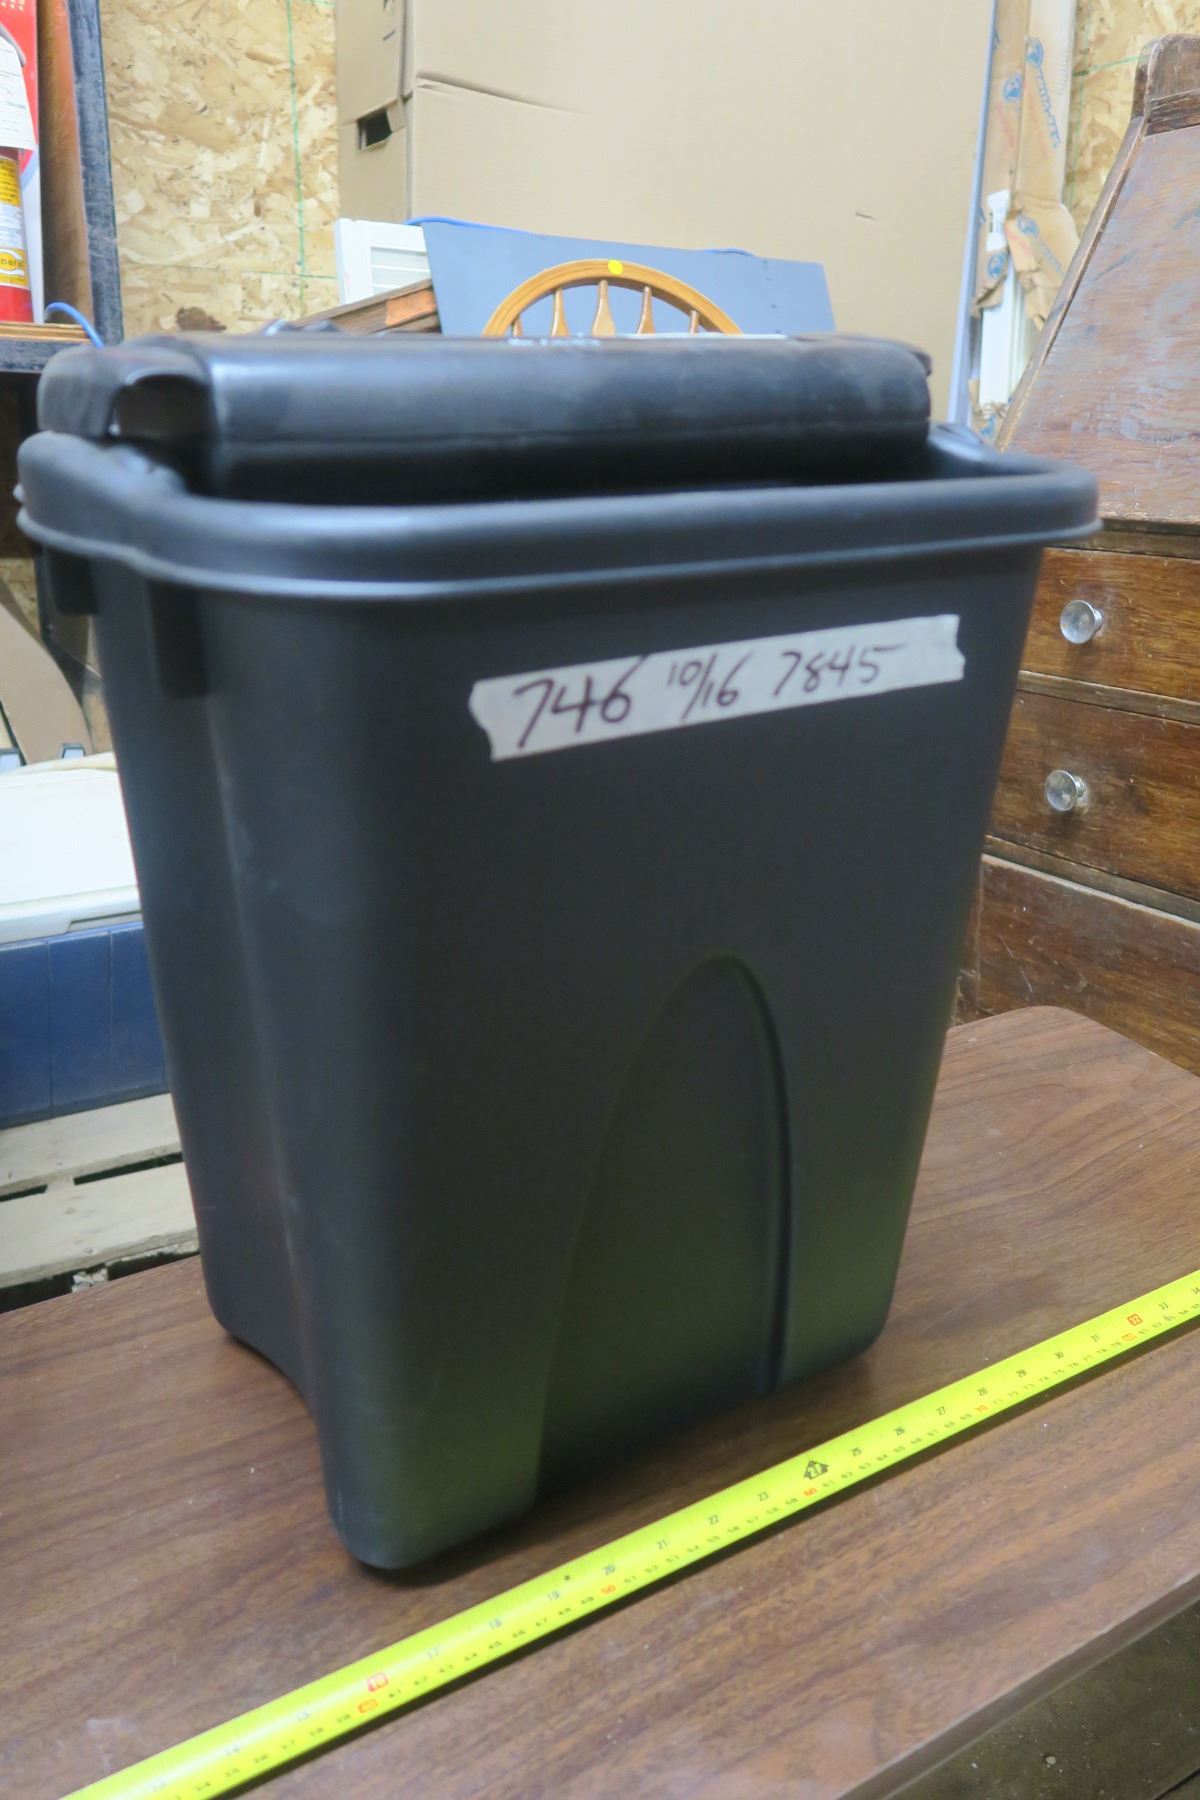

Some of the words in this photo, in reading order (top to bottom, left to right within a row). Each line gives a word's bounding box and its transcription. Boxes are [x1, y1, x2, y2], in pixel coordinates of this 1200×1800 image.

[513, 655, 647, 748] 746
[666, 650, 755, 720] 10/16
[774, 643, 906, 697] 7845
